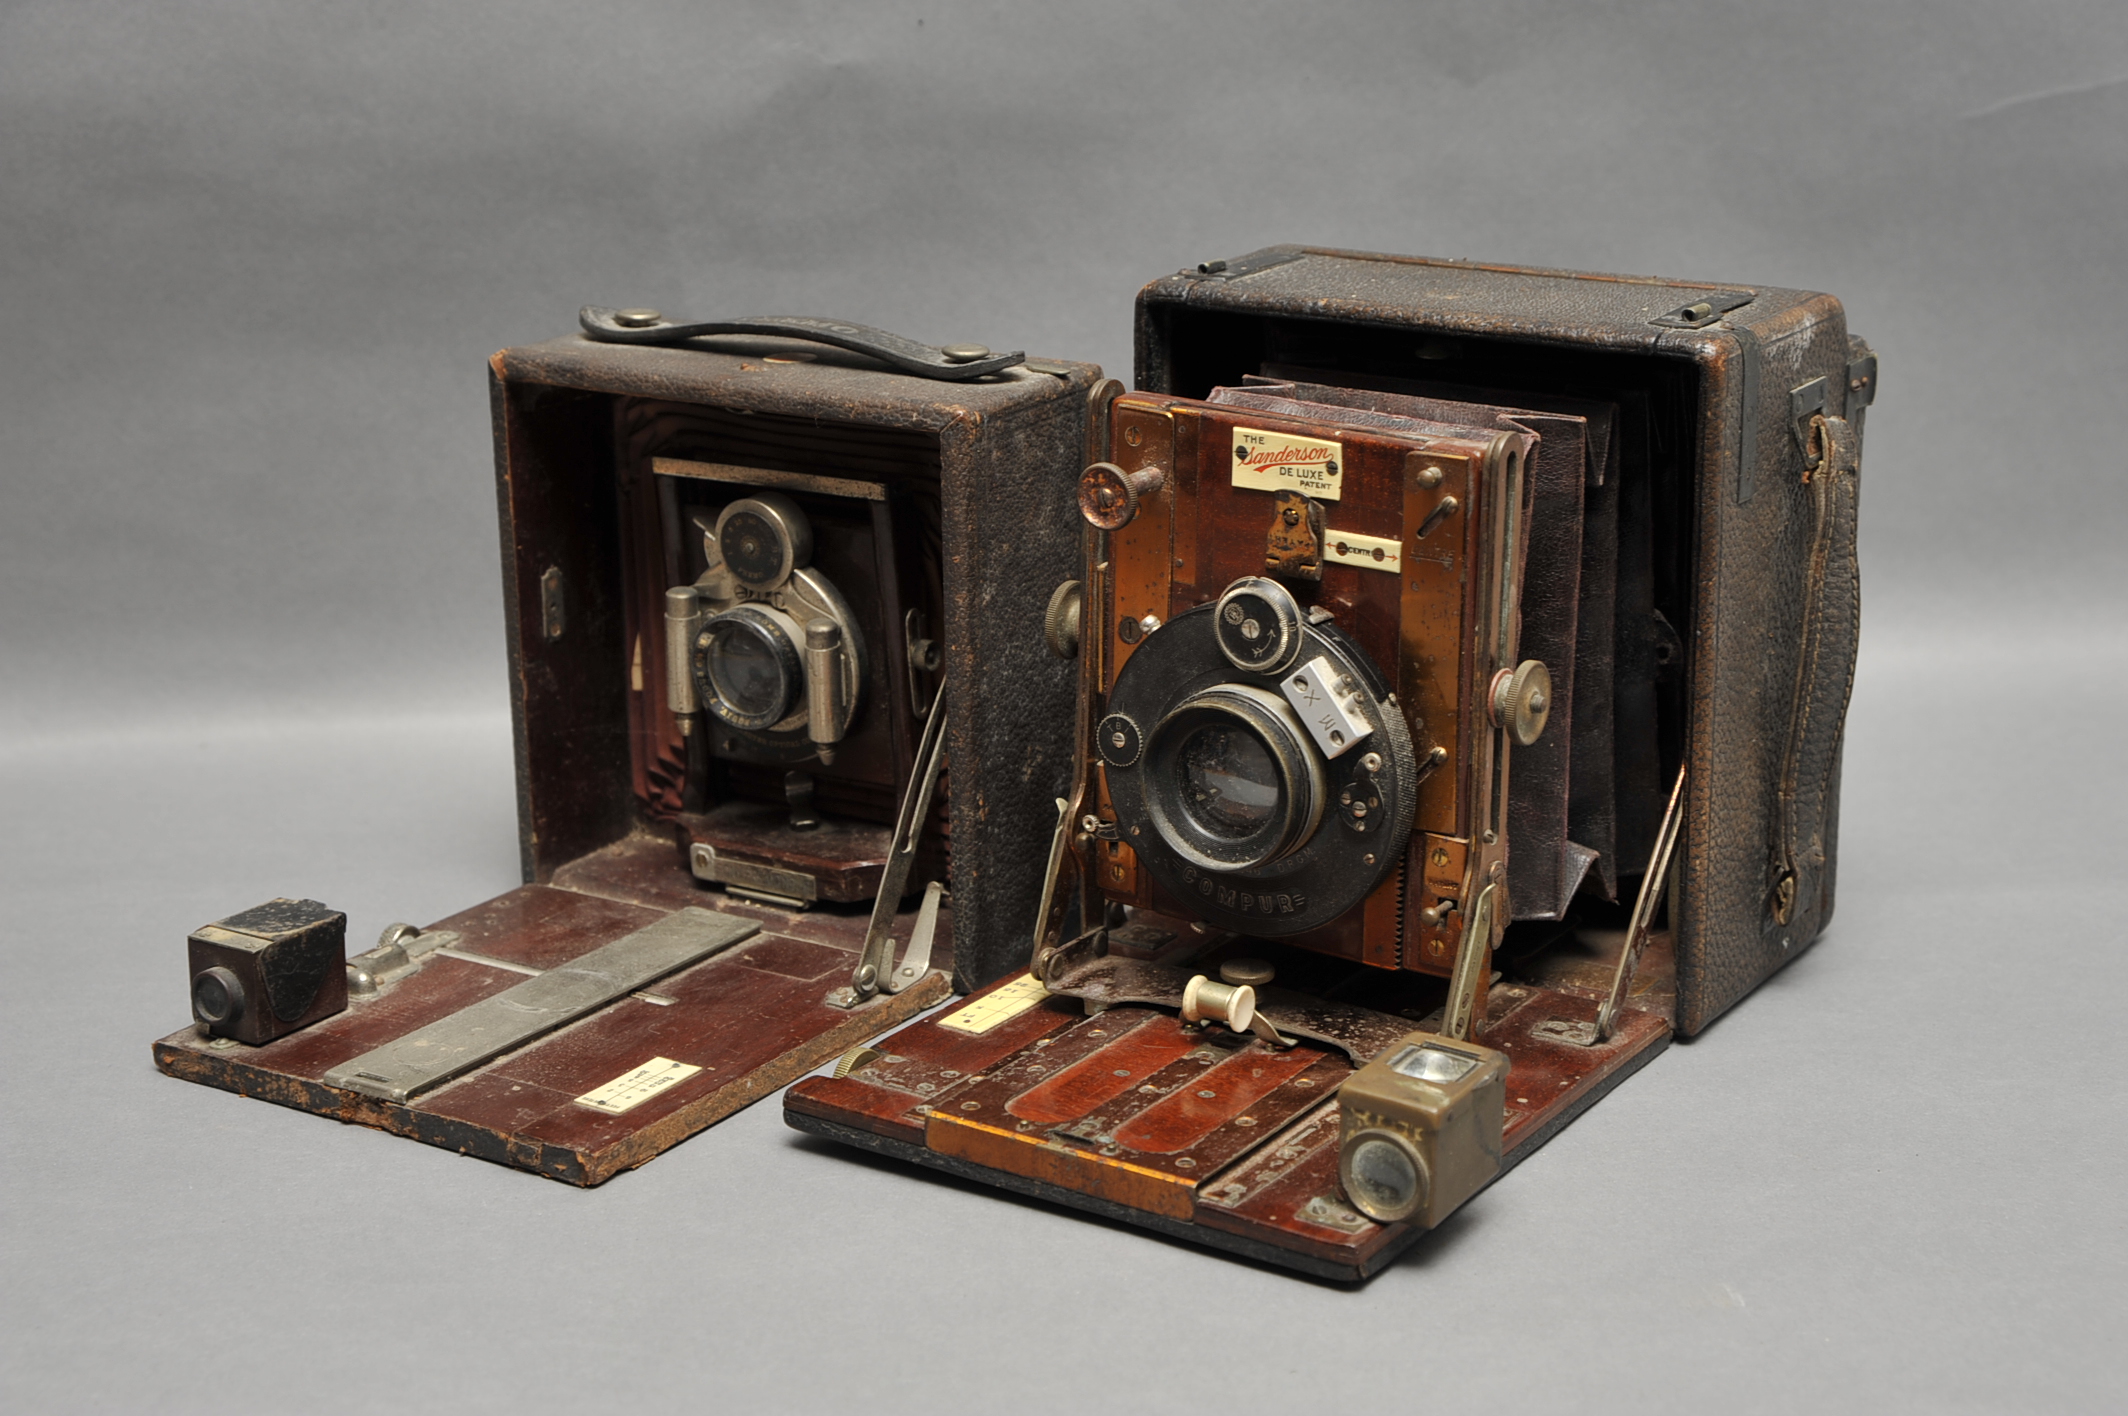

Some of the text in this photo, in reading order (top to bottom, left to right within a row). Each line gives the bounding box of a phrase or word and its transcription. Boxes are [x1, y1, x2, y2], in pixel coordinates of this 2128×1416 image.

[1243, 434, 1265, 446] THE
[1238, 445, 1334, 469] Sanderson
[1279, 466, 1324, 481] DE LUXE
[1299, 480, 1333, 490] PATENT
[1348, 546, 1373, 557] CENTR
[1303, 689, 1322, 707] X
[1115, 721, 1122, 731] B
[1182, 865, 1295, 914] COMPUR
